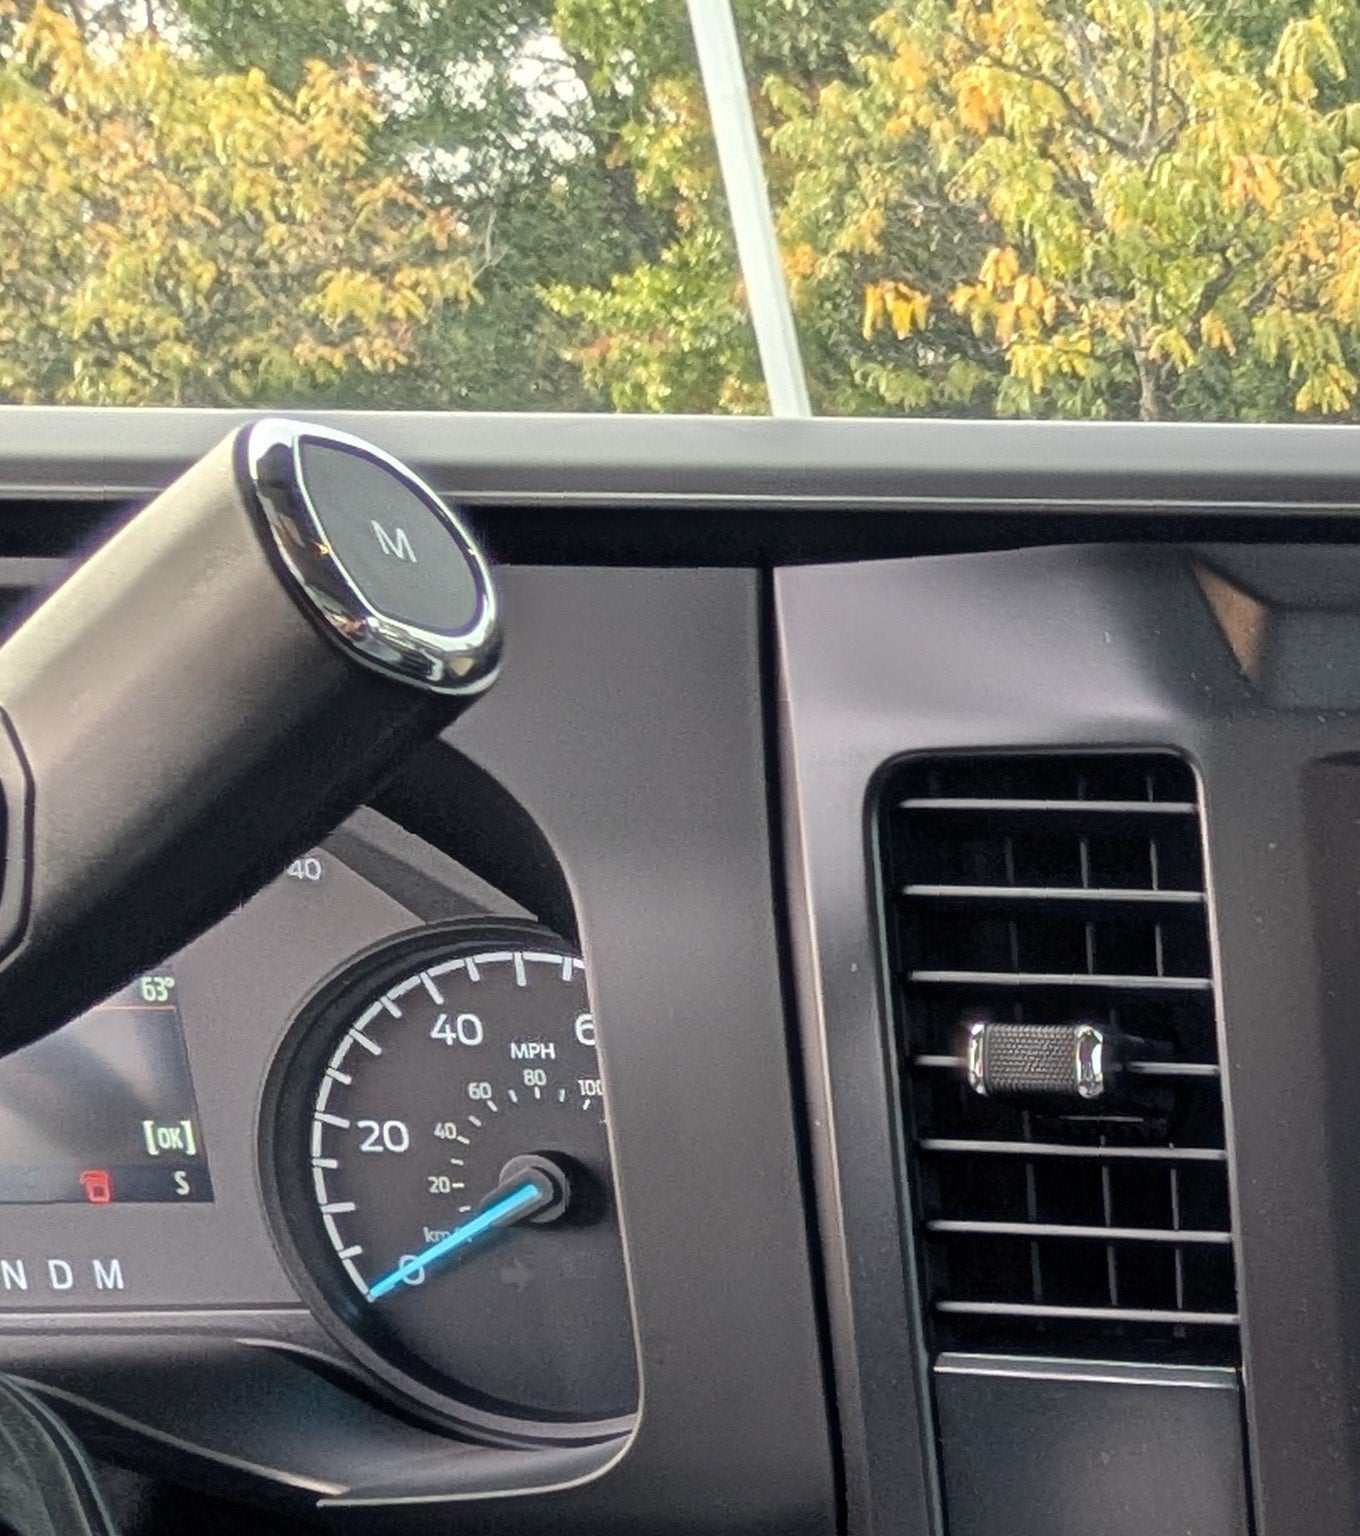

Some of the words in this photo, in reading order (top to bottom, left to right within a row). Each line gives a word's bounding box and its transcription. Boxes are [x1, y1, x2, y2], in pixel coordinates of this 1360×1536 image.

[370, 519, 418, 564] M
[286, 857, 323, 882] 40
[430, 1013, 484, 1046] 40
[575, 1014, 597, 1047] 6
[510, 1042, 556, 1060] MPH
[523, 1069, 547, 1086] 80
[468, 1082, 492, 1100] 60
[357, 1119, 410, 1153] 20
[434, 1122, 457, 1140] 40
[174, 1171, 190, 1195] S
[428, 1176, 450, 1193] 20
[1, 1260, 28, 1291] N
[48, 1260, 73, 1290] D
[93, 1259, 125, 1290] M
